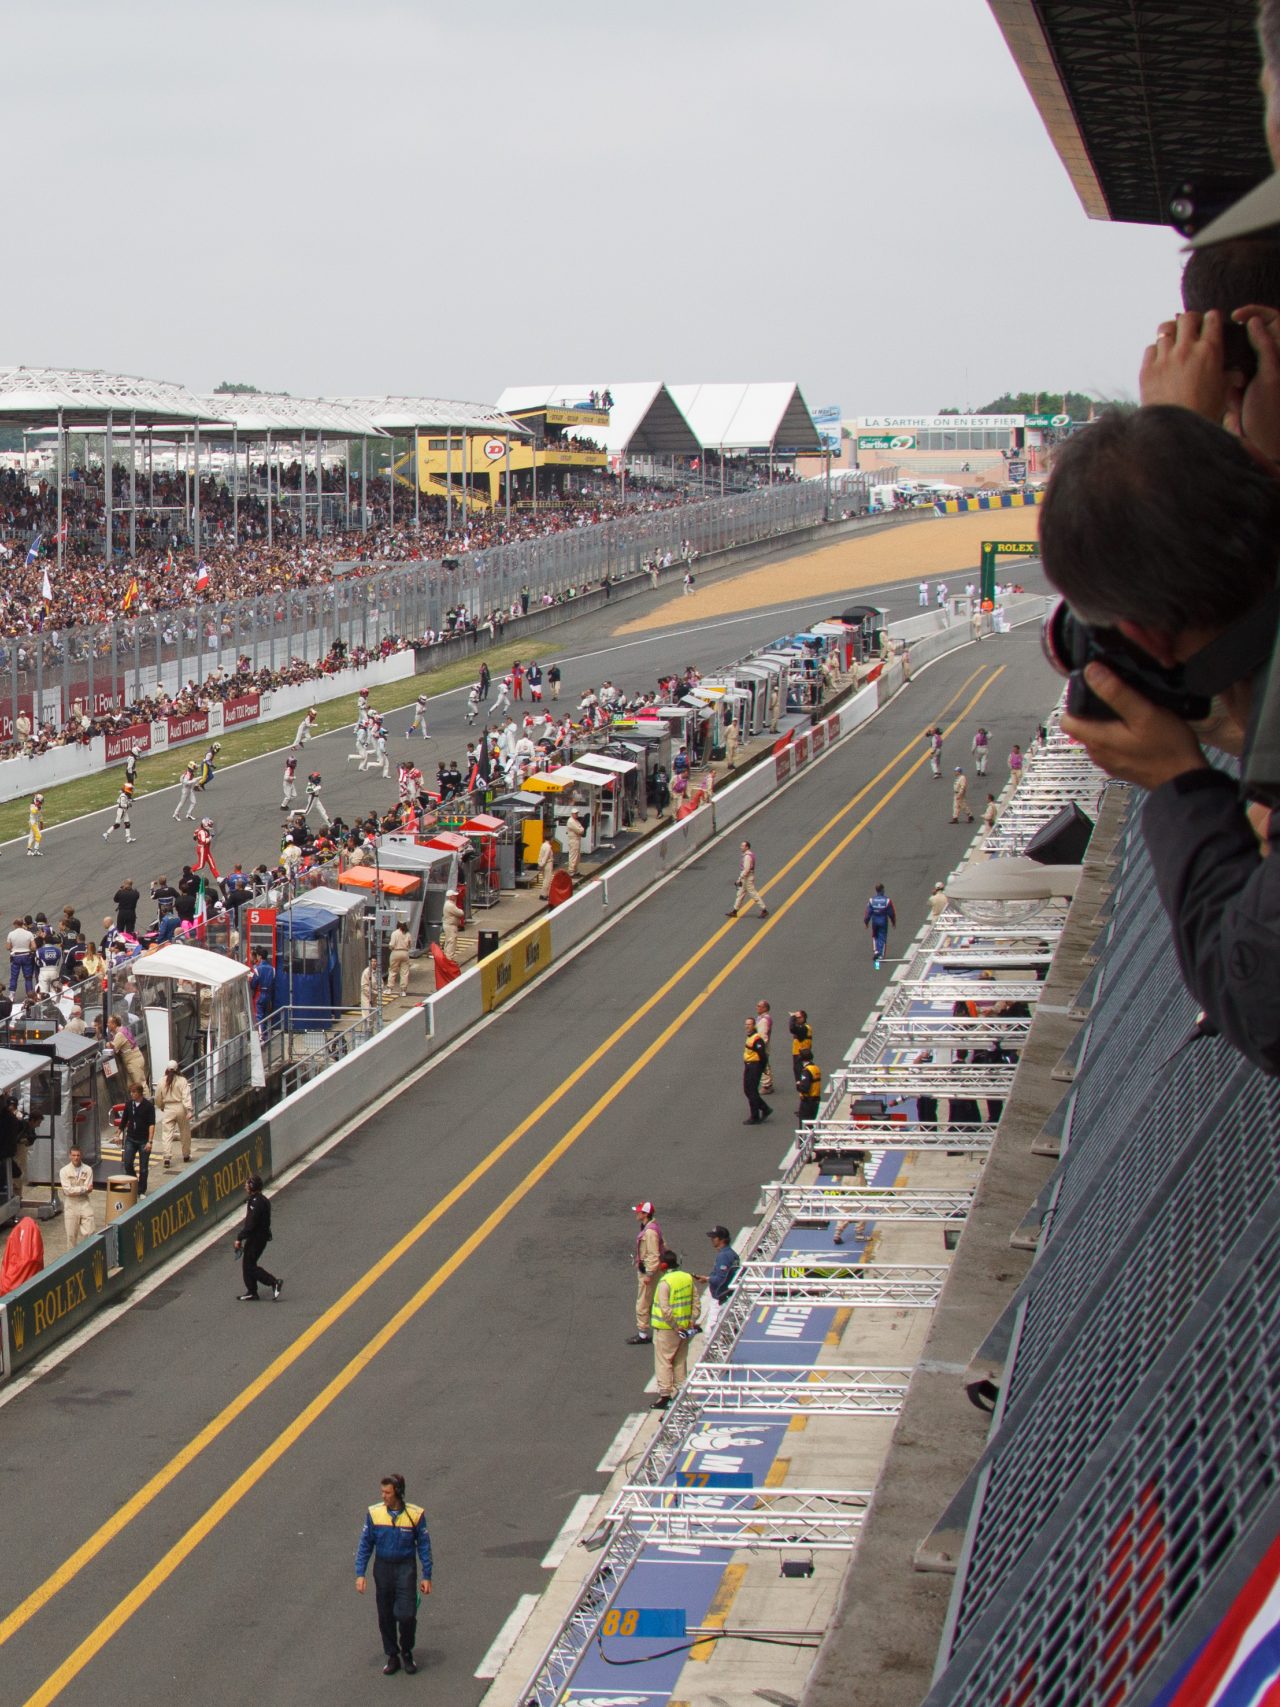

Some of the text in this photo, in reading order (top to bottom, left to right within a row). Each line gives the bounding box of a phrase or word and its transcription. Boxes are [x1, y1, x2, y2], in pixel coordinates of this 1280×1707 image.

[865, 417, 1017, 427] LA SARTHE, ON EN EST FIER
[1025, 417, 1048, 426] Sarthe
[859, 440, 889, 449] Sarthe
[997, 543, 1034, 552] ROLEX
[225, 703, 259, 721] Audi TDI Power
[170, 718, 207, 739] Audi TDI Power
[107, 734, 149, 757] Audi TDI Power
[250, 911, 260, 923] 5
[214, 1150, 254, 1202] ROLEX
[151, 1192, 196, 1249] ROLEX
[33, 1268, 87, 1336] ROLEX
[684, 1473, 710, 1488] 77
[602, 1609, 640, 1637] 88
